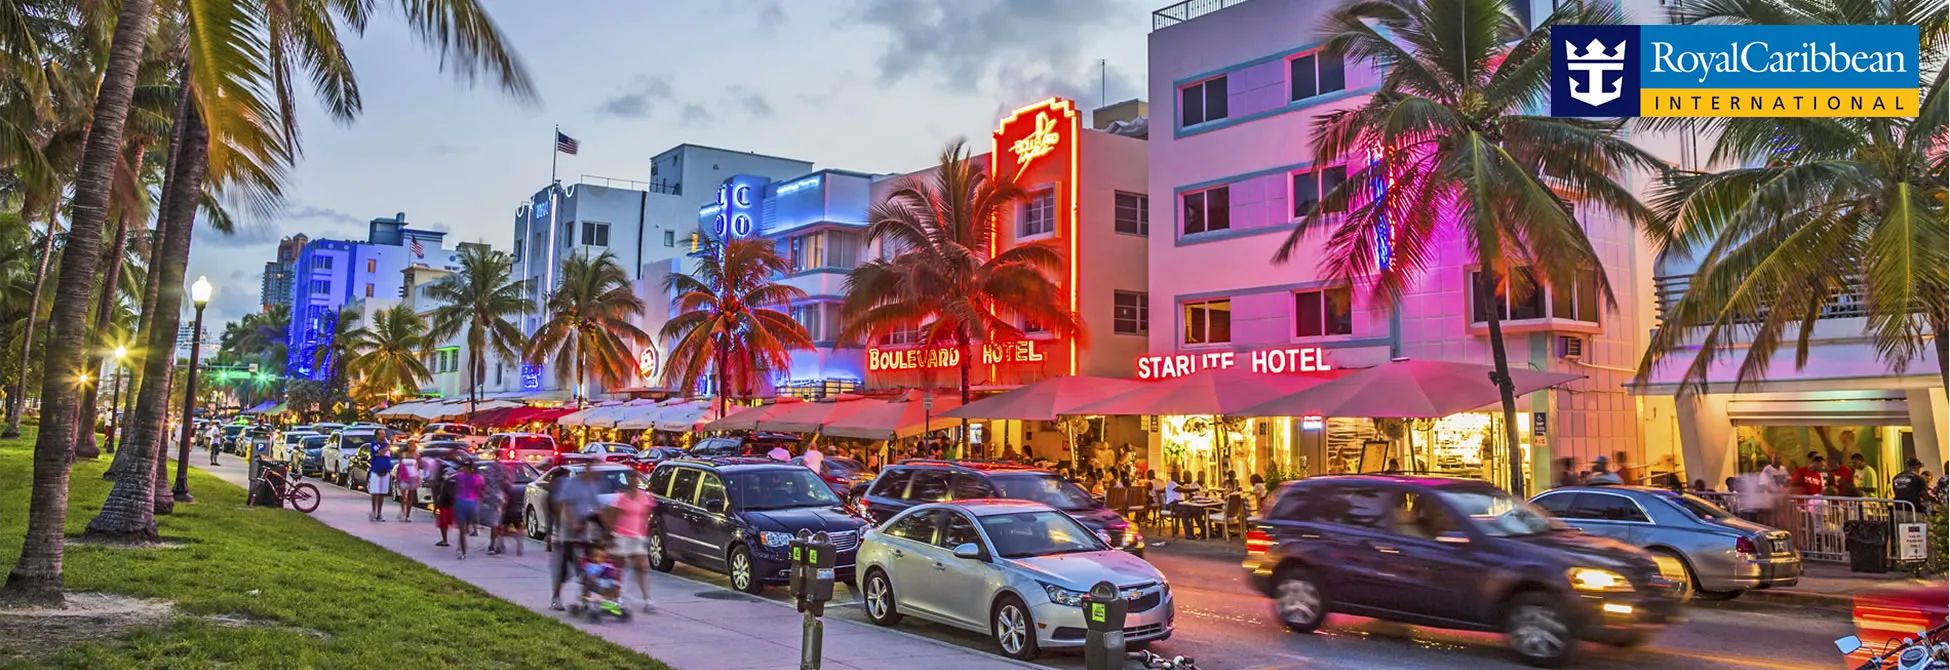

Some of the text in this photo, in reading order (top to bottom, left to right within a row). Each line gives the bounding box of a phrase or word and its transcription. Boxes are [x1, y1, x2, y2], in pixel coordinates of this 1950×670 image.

[869, 340, 1043, 370] BOULEVARD HOTEL
[1138, 347, 1331, 379] STARLITE HOTEL
